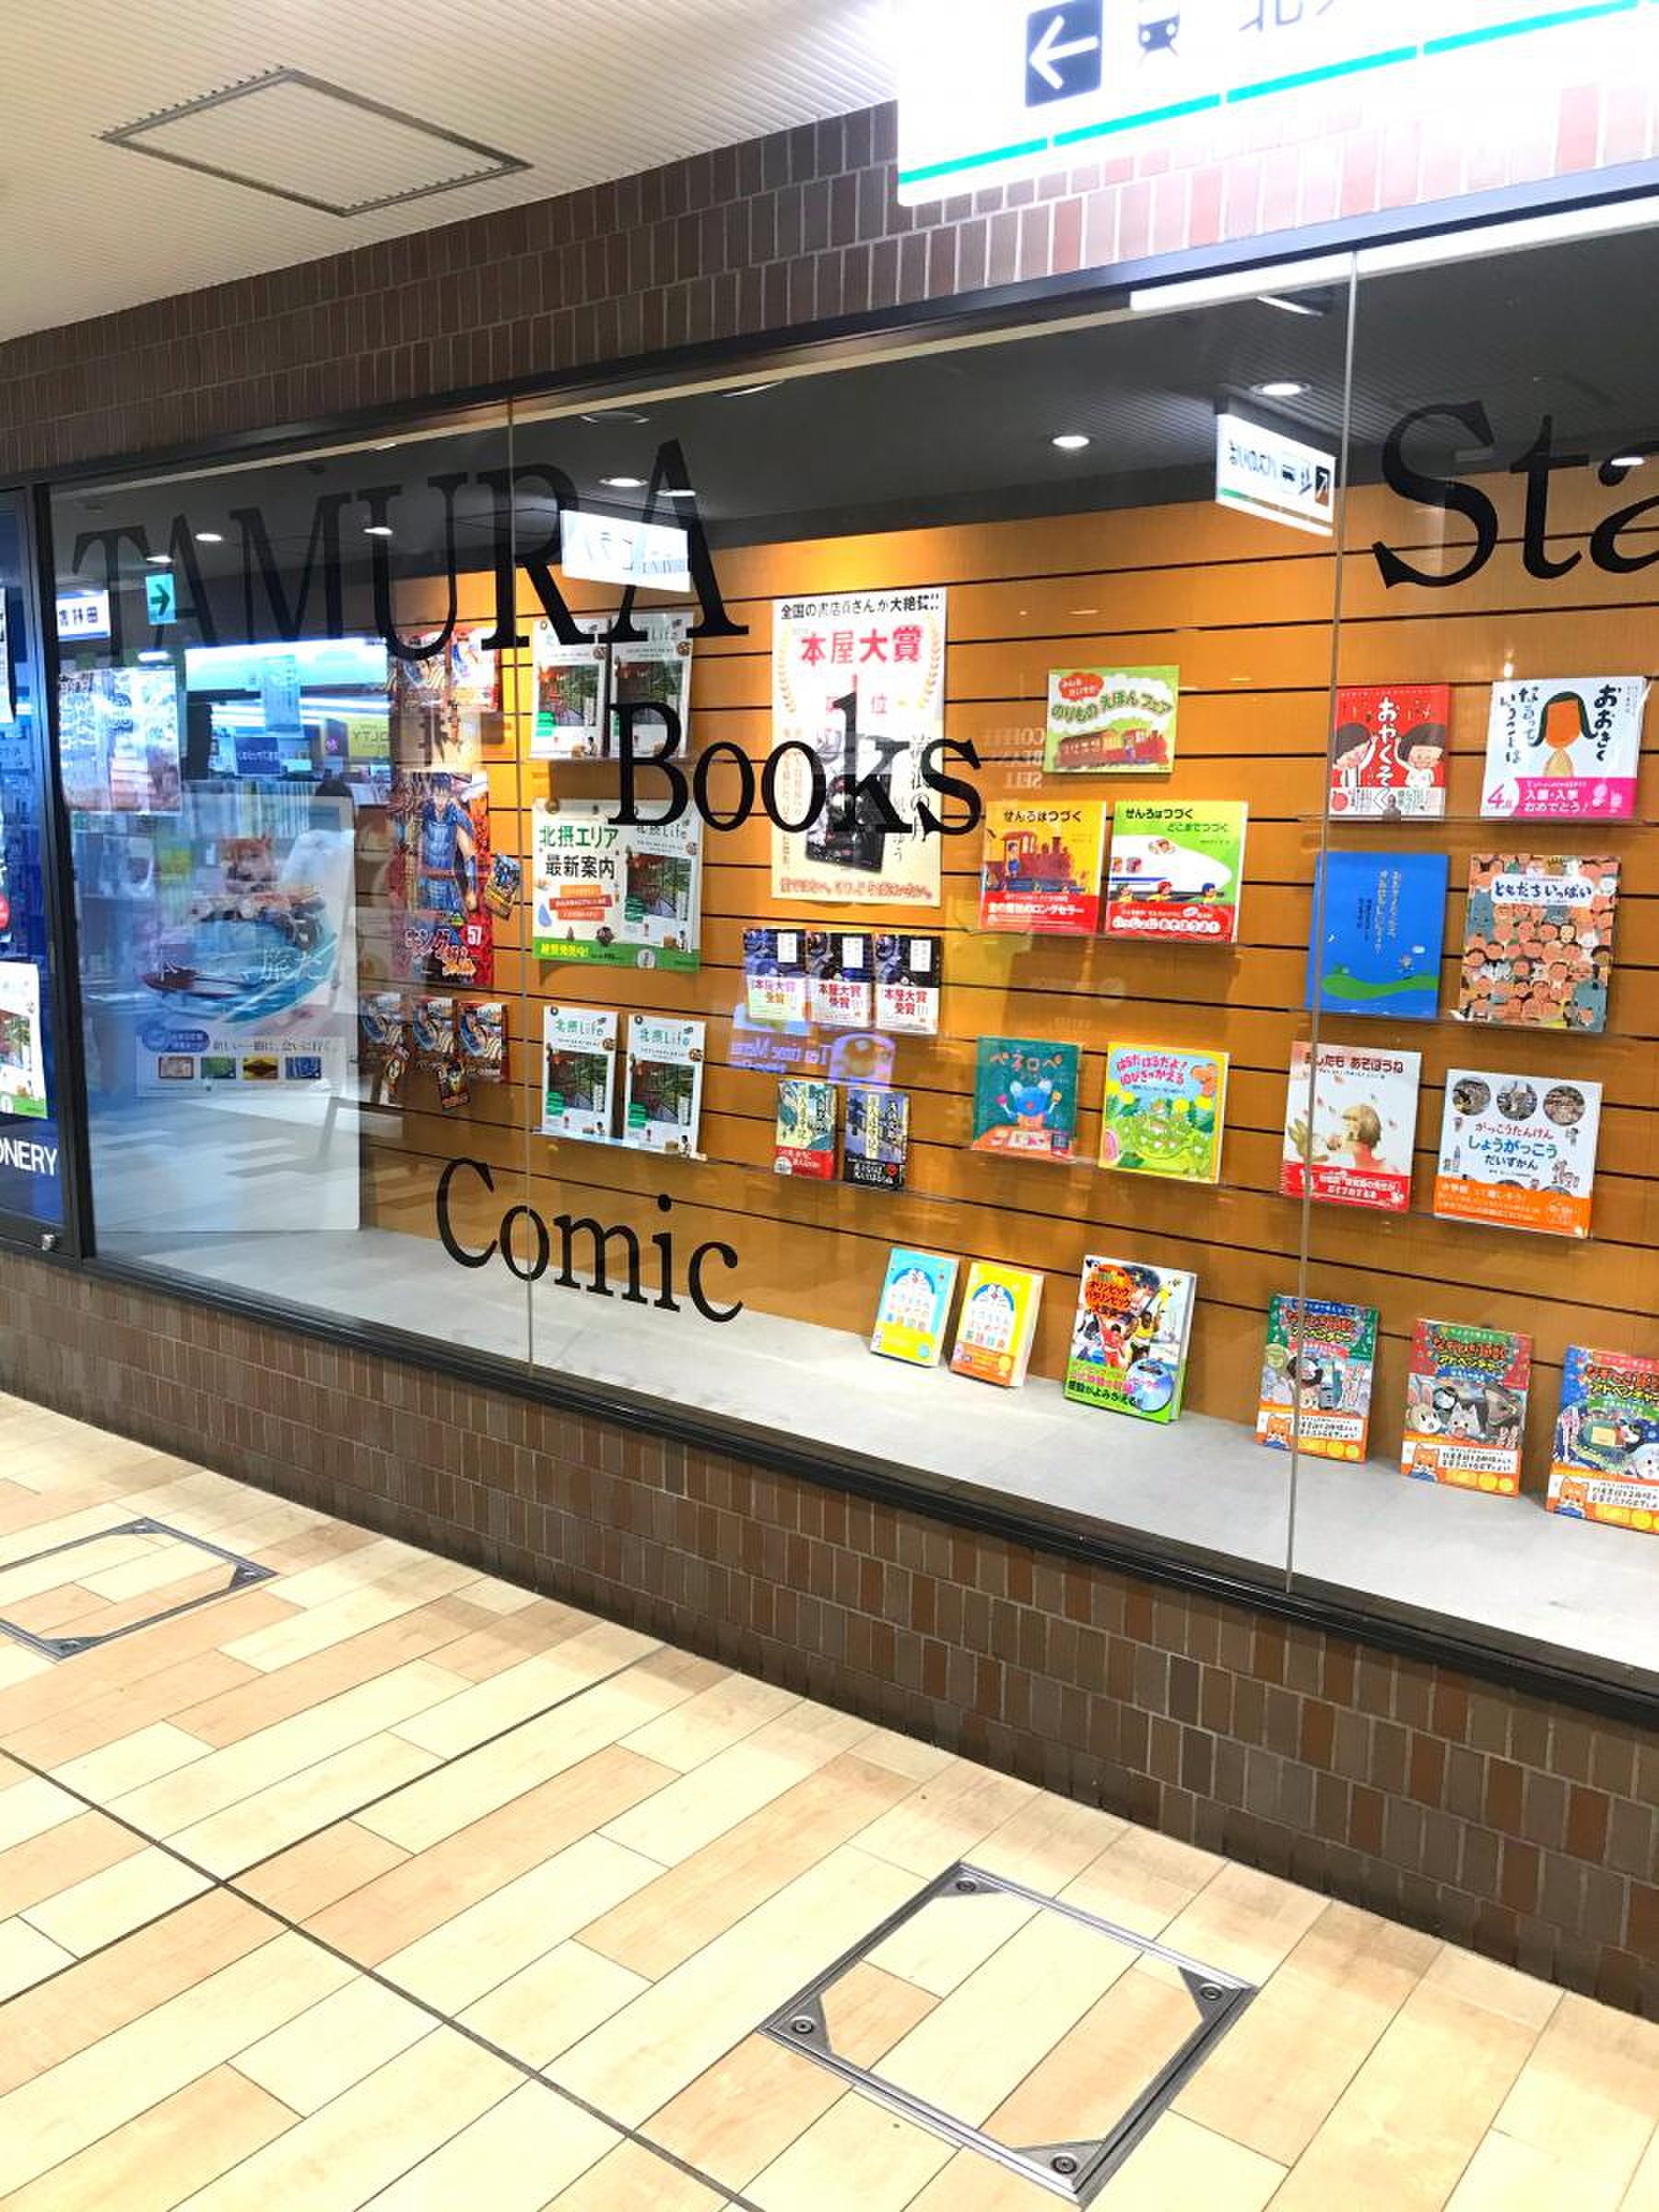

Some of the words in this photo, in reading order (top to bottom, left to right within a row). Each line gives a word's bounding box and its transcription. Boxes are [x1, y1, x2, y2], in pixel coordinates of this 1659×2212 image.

[72, 438, 748, 663] TAMURA
[800, 625, 924, 666] 本屋大賞
[1594, 685, 1622, 762] おおきく
[606, 692, 982, 836] Books
[1004, 809, 1082, 823] せんろはつづく
[1125, 808, 1194, 820] せんろはつづく
[538, 822, 619, 849] 北摂エリア
[545, 854, 616, 880] 最新案内
[467, 925, 483, 946] 57
[818, 982, 862, 998] 本屋大賞
[884, 988, 928, 1004] 本屋大賞
[1468, 1135, 1559, 1159] しょうがっこう
[436, 1158, 744, 1324] Comic
